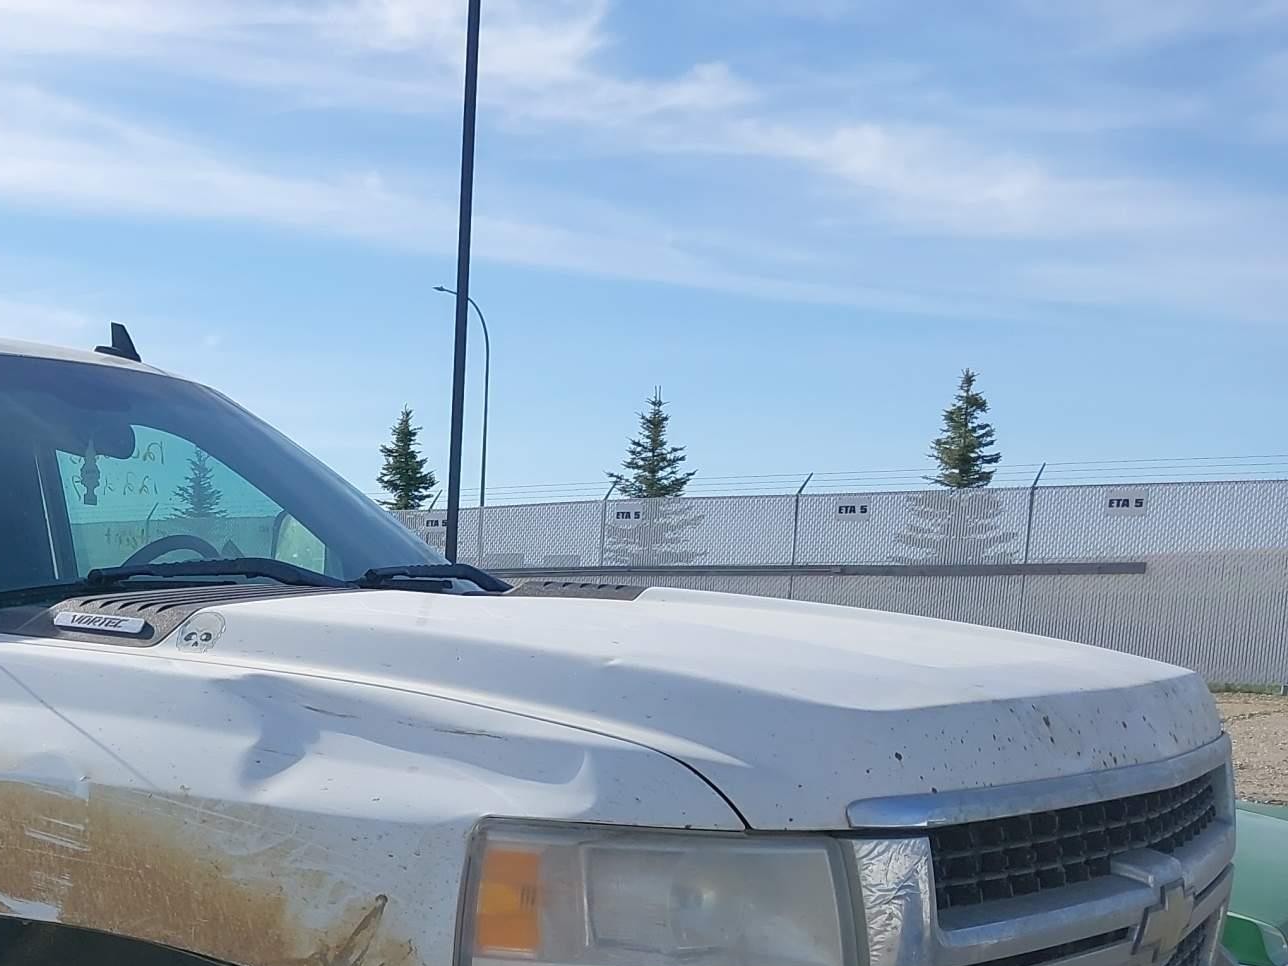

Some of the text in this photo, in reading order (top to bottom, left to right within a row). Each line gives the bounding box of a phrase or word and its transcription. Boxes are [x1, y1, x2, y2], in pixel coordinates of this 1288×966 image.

[1108, 498, 1145, 508] ETA 5
[838, 505, 868, 514] ETA 5
[616, 511, 641, 520] ETA 5
[426, 519, 439, 528] ETA
[70, 614, 130, 629] VORTEC
